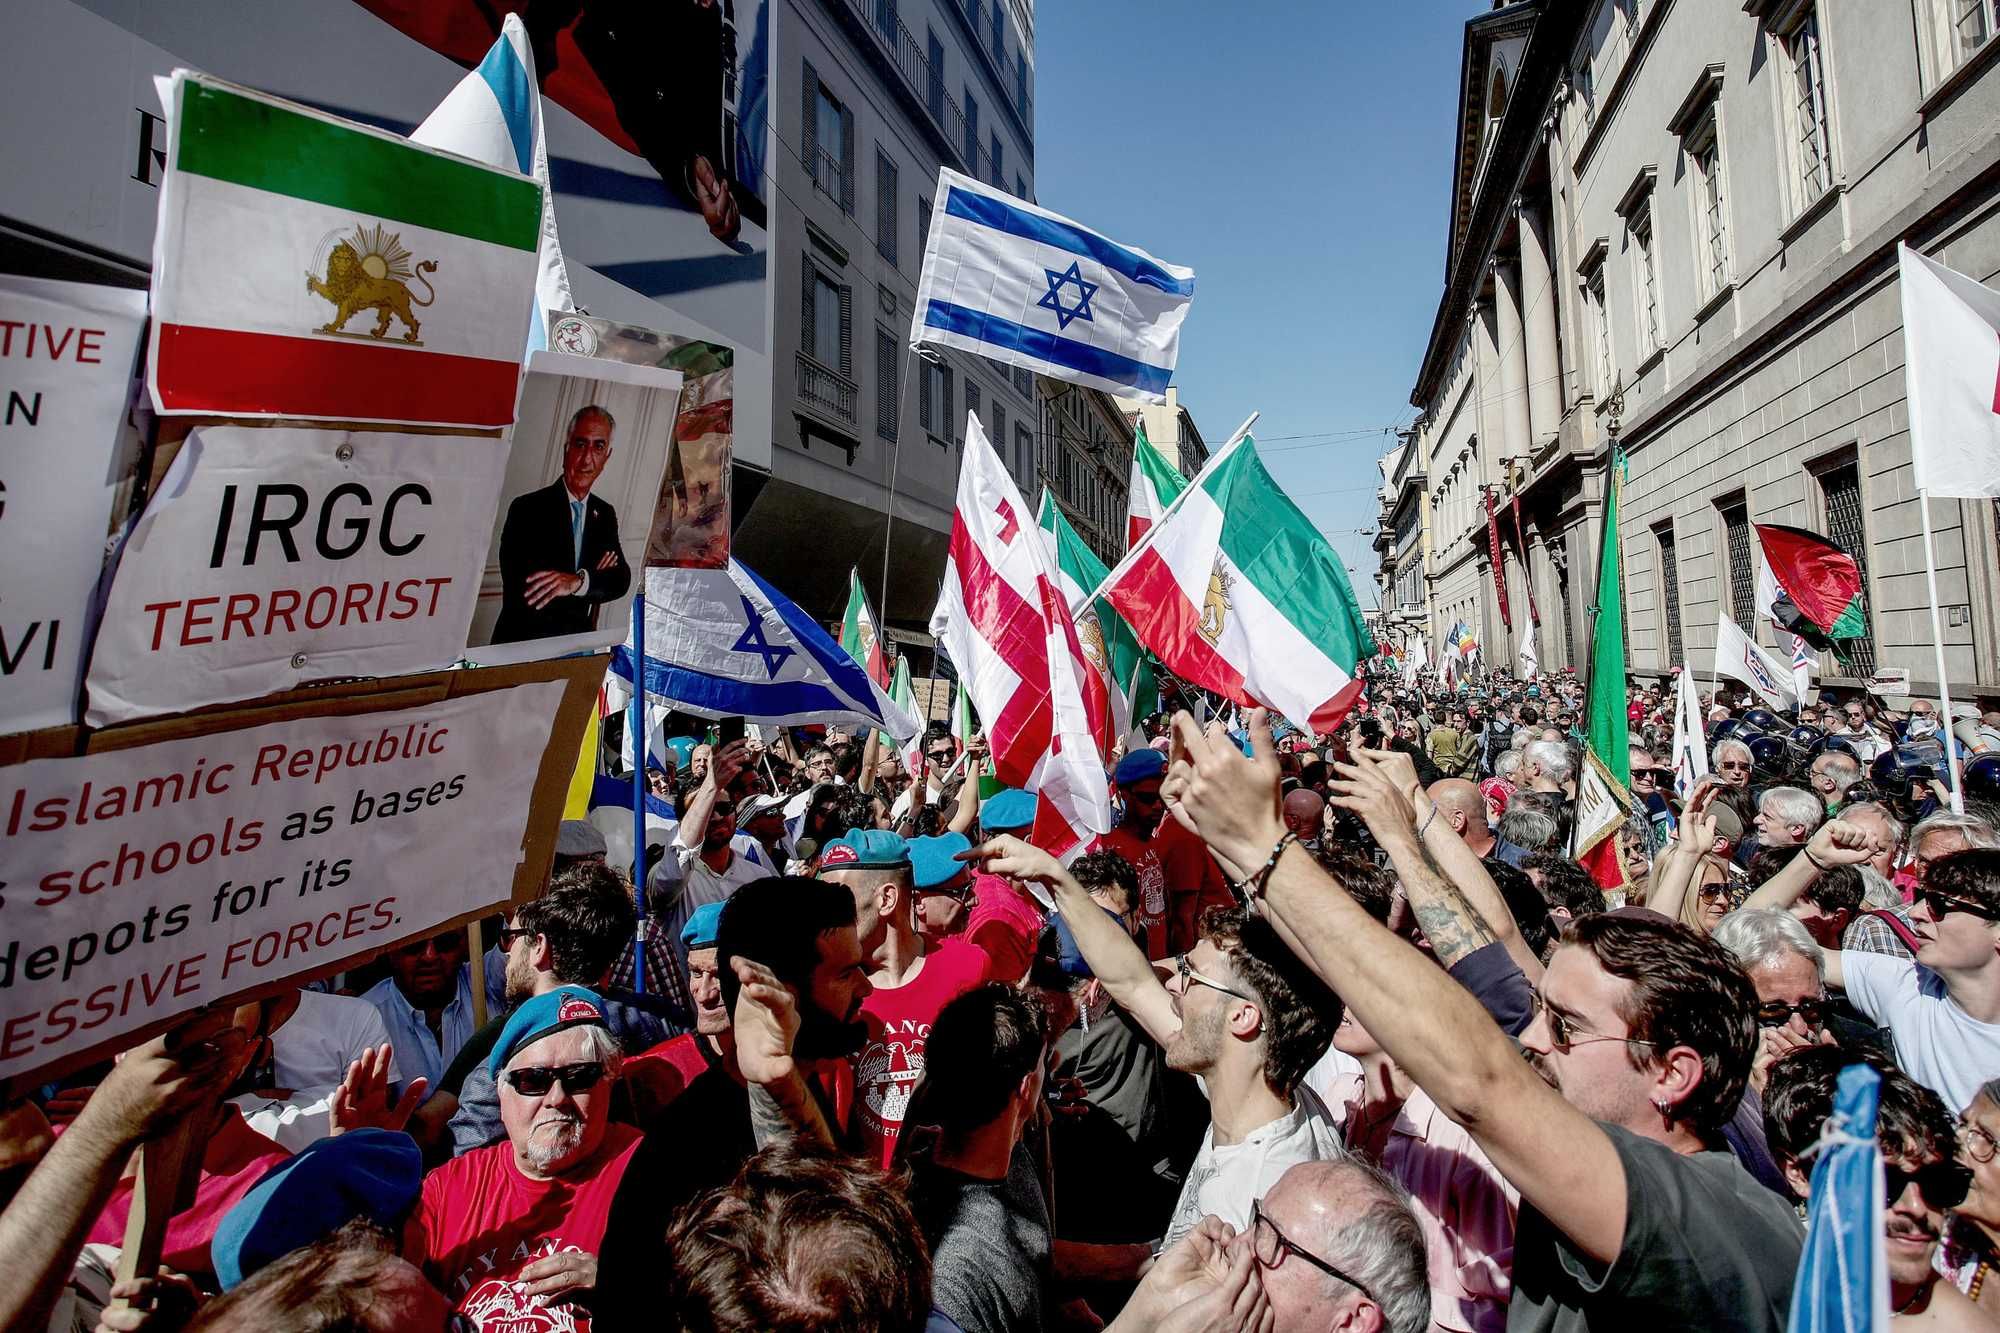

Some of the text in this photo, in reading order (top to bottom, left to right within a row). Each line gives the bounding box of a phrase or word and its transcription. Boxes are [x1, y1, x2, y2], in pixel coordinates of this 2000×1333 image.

[210, 483, 432, 569] IRGC
[144, 577, 453, 651] TERRORIST
[7, 723, 450, 837] Islamic Republic
[34, 815, 265, 908] schools
[281, 805, 335, 841] as
[350, 772, 467, 826] bases
[0, 856, 353, 989] depots for its
[0, 896, 403, 1063] ESSIVE FORCES.
[883, 1071, 917, 1082] ITALIA
